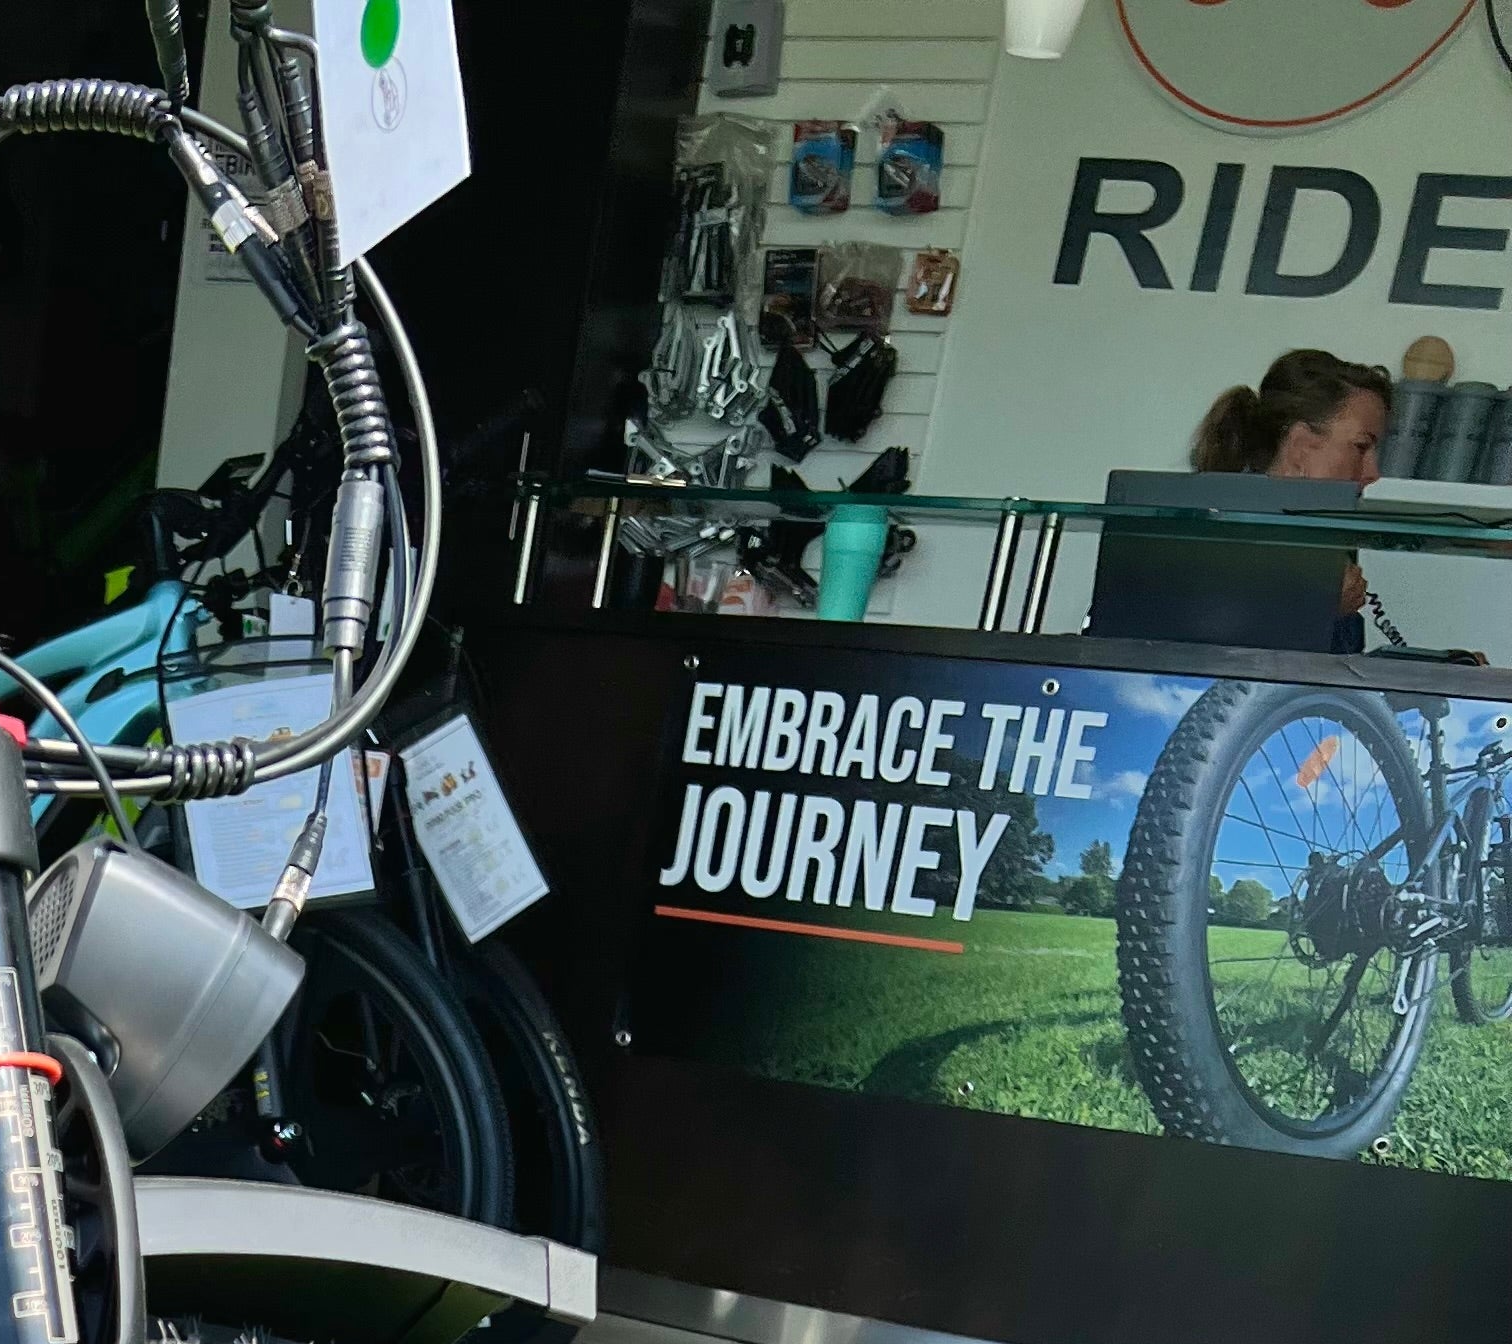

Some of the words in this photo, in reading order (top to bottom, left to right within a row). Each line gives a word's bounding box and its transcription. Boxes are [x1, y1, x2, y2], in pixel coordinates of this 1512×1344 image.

[1052, 156, 1512, 310] RIDE
[683, 682, 965, 786] EMBRACE
[979, 703, 1108, 799] THE
[659, 784, 1010, 921] JOURNEY
